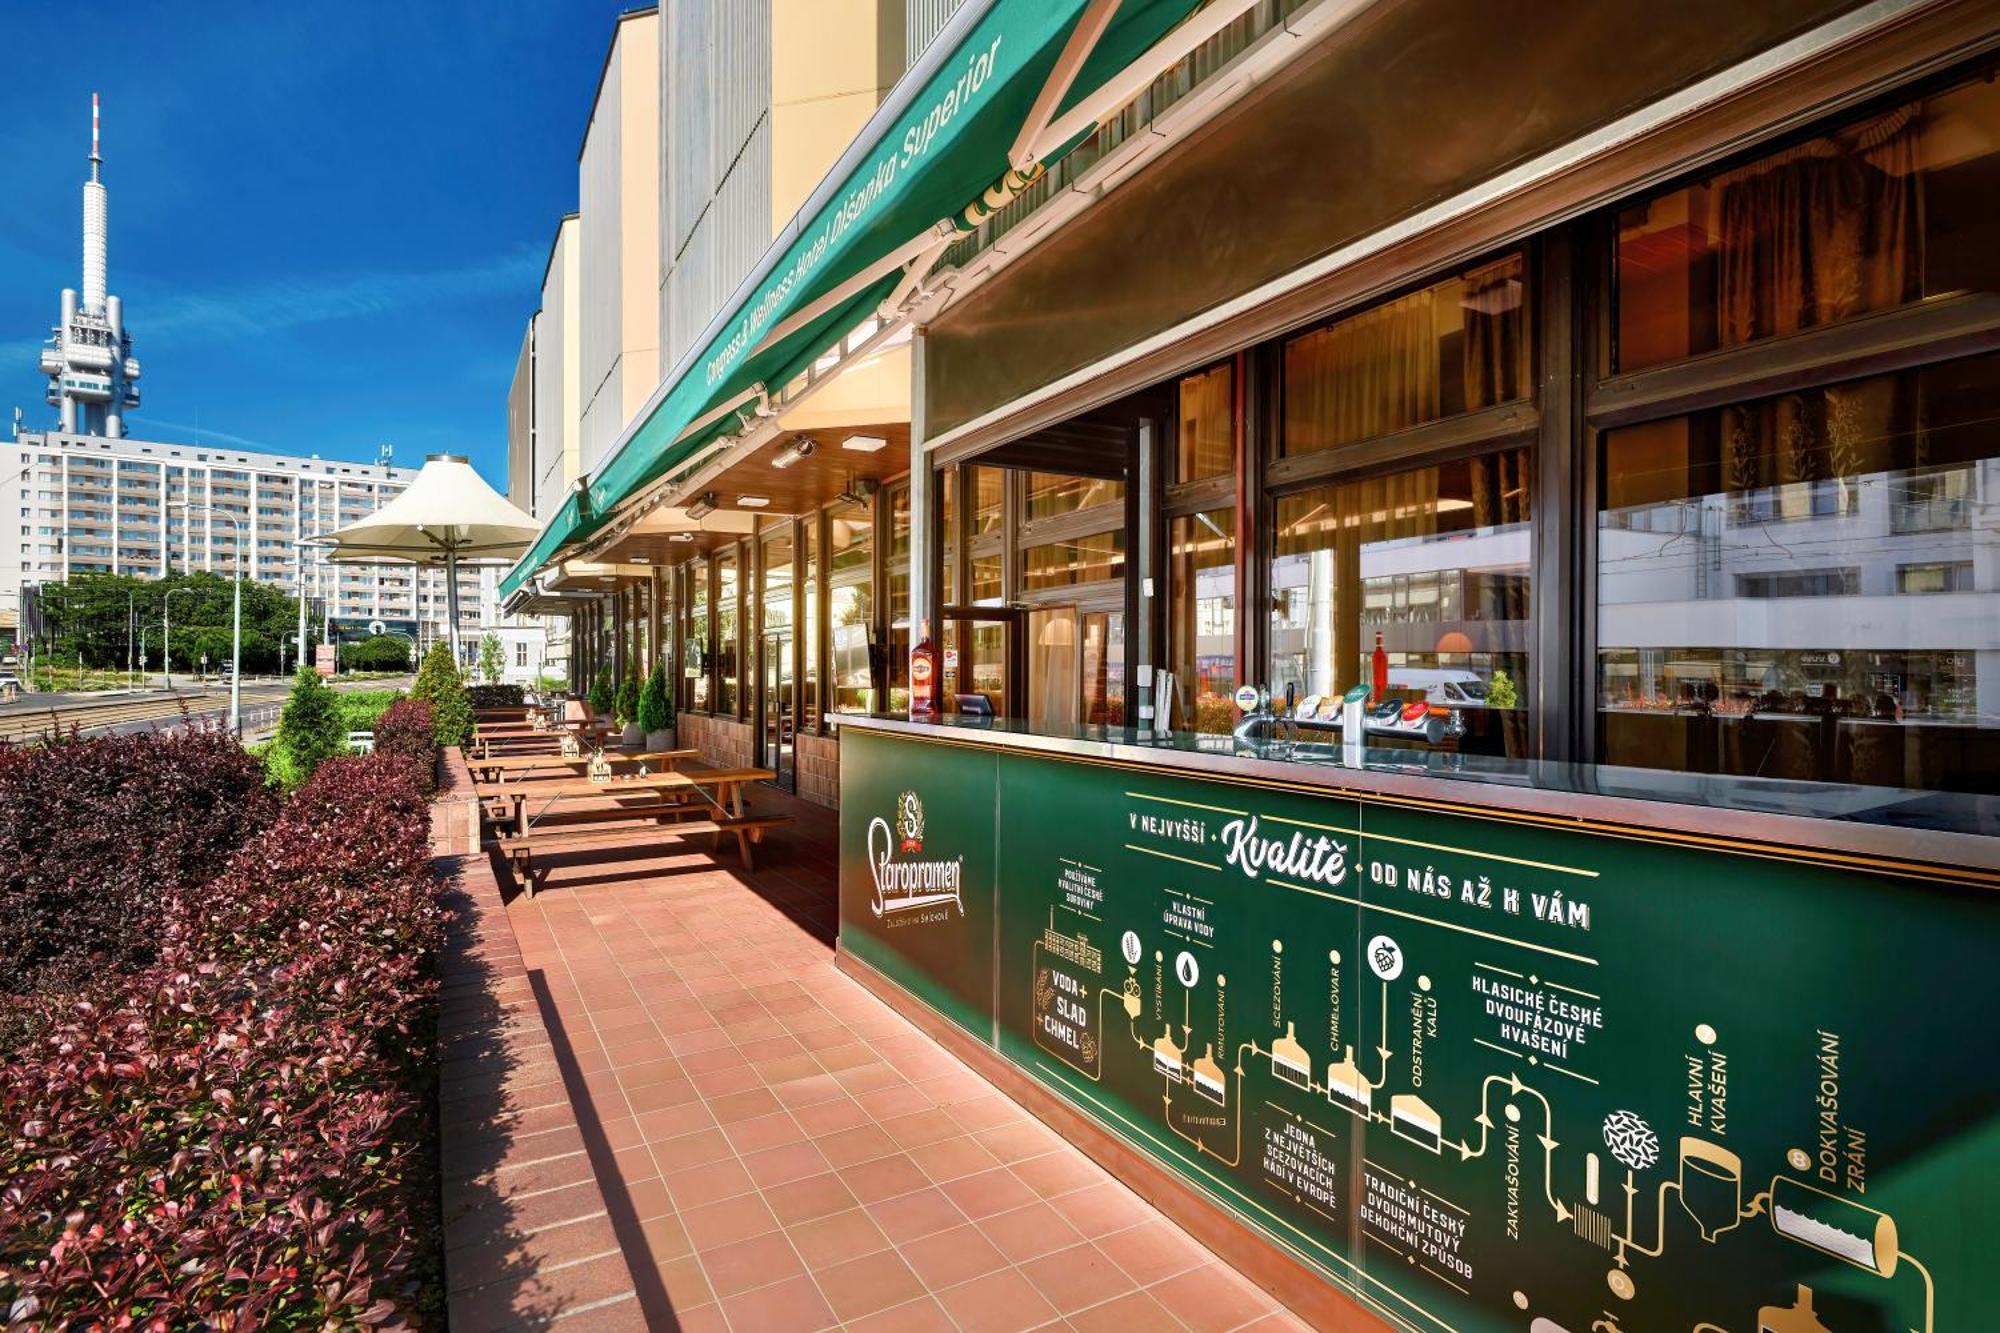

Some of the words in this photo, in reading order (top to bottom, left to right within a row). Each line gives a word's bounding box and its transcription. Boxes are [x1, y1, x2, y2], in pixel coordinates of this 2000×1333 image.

[707, 335, 742, 386] Congress
[750, 269, 795, 335] Wellness
[794, 221, 830, 288] Hotel
[831, 156, 897, 246] Olšanka
[901, 35, 1001, 168] Superior
[868, 817, 964, 918] Staropramen
[1129, 812, 1139, 831] V
[1141, 813, 1206, 844] NEJVYŠŠÍ
[1220, 814, 1349, 886] Kvalitě
[1370, 860, 1398, 887] OD
[1406, 864, 1451, 899] NÁS
[1460, 876, 1493, 907] AŽ
[1502, 884, 1521, 914] K
[1531, 889, 1592, 931] VÁM
[1163, 909, 1194, 932] ÚPRAVA
[1194, 920, 1215, 939] VODY
[1172, 900, 1205, 921] VLASTNÍ
[1052, 970, 1078, 996] VODA
[1056, 996, 1087, 1027] SLAD
[1272, 955, 1281, 1029] SCEZOVÁNÍ
[1330, 967, 1340, 1052] CHMELOVAR
[1472, 975, 1545, 1010] KLASICKÉ
[1549, 993, 1603, 1029] ČESKÉ
[1044, 1015, 1079, 1050] CHMEL
[1409, 991, 1423, 1088] ODSTRANĚNÍ
[1424, 997, 1437, 1038] KALŮ
[1485, 998, 1586, 1045] DVOUFÁZOVÉ
[1501, 1023, 1568, 1059] KVAŠENÍ
[1685, 1053, 1704, 1127] HLAVNÍ
[1706, 1049, 1728, 1136] KVAŠENÍ
[1815, 1028, 1841, 1184] DOKVAŠOVÁNÍ
[1264, 1127, 1271, 1140] Z
[1273, 1131, 1335, 1175] NEJVĚTŠÍCH
[1284, 1123, 1316, 1148] JEDNA
[1845, 1126, 1867, 1194] ZRÁNÍ
[1263, 1156, 1286, 1179] KÁDÍ
[1288, 1170, 1295, 1184] V
[1297, 1176, 1337, 1209] EVROPĚ
[1267, 1145, 1333, 1190] SCEZOVACÍCH
[1503, 1121, 1520, 1240] ZAKVAŠOVÁNÍ
[1364, 1172, 1420, 1217] TRADIČNÍ
[1422, 1198, 1466, 1237] ČESKÝ
[1368, 1192, 1461, 1252] DVOURMUTOVÝ
[1360, 1205, 1419, 1250] DEKOKČNÍ
[1422, 1232, 1474, 1280] ZPŮSOB
